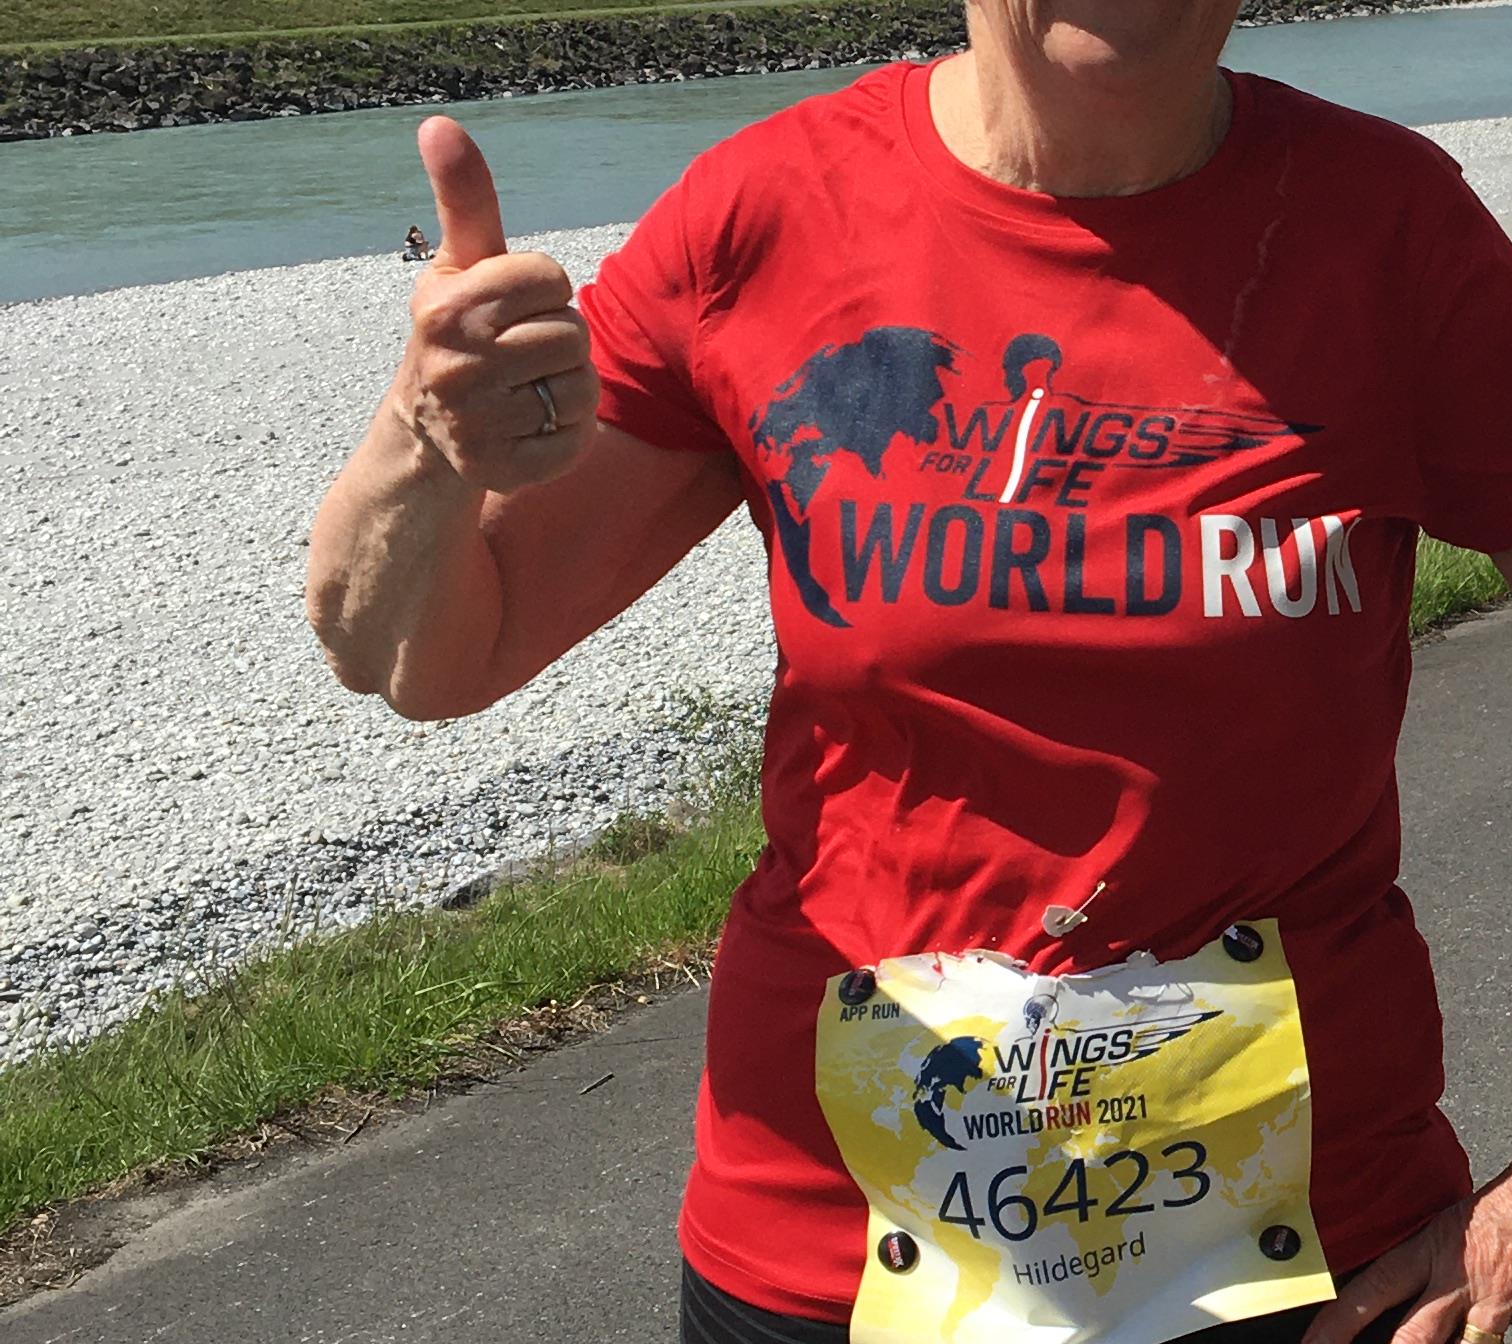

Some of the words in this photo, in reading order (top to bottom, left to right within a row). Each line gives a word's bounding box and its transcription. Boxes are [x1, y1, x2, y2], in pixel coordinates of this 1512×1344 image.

[919, 452, 972, 474] FOR
[840, 1005, 868, 1022] APP
[872, 1003, 900, 1020] RUN
[987, 1076, 1017, 1092] FOR
[1097, 1094, 1148, 1124] 2021
[938, 1139, 1211, 1243] 46423
[1012, 1231, 1147, 1286] Hildegard
